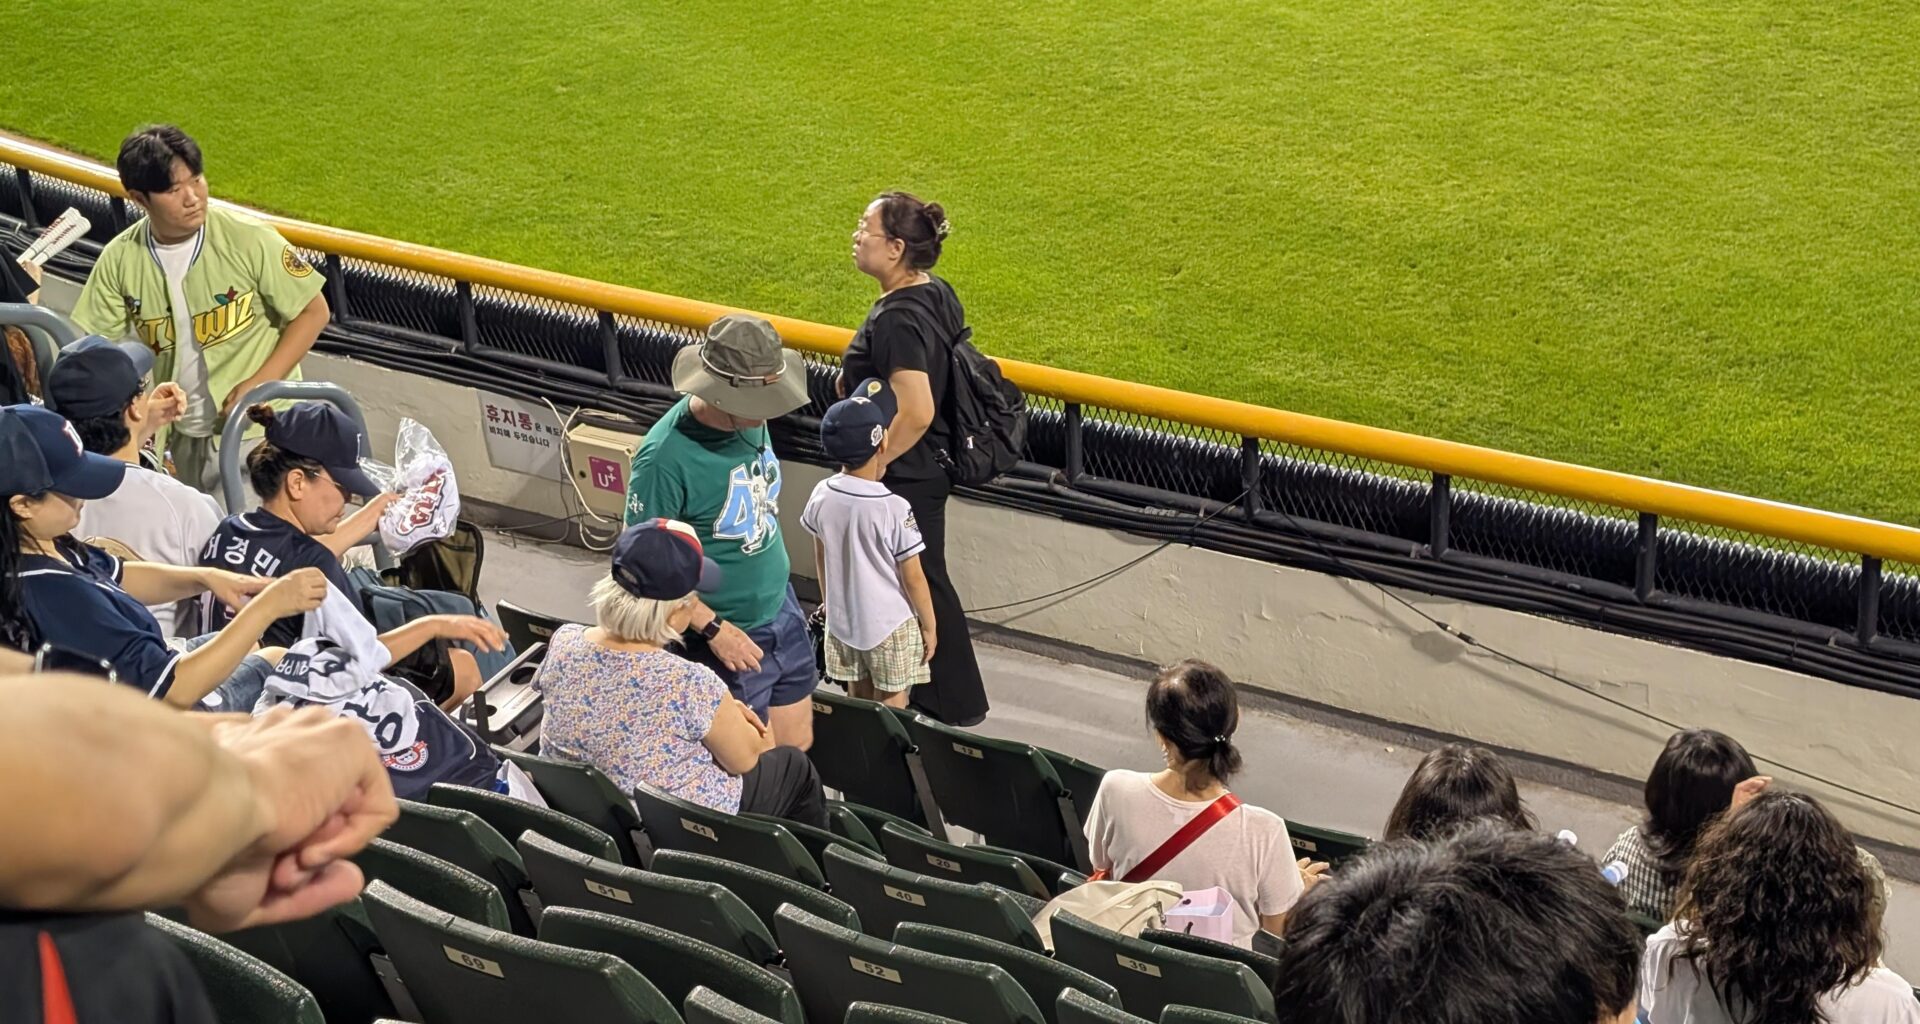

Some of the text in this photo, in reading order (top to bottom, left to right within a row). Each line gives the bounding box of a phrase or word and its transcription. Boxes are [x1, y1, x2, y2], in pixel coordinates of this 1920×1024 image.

[692, 824, 707, 836] 41
[936, 858, 951, 869] 20
[598, 885, 616, 898] 51
[896, 891, 912, 902] 40
[461, 954, 485, 971] 69
[1129, 960, 1147, 972] 39
[864, 963, 886, 977] 52
